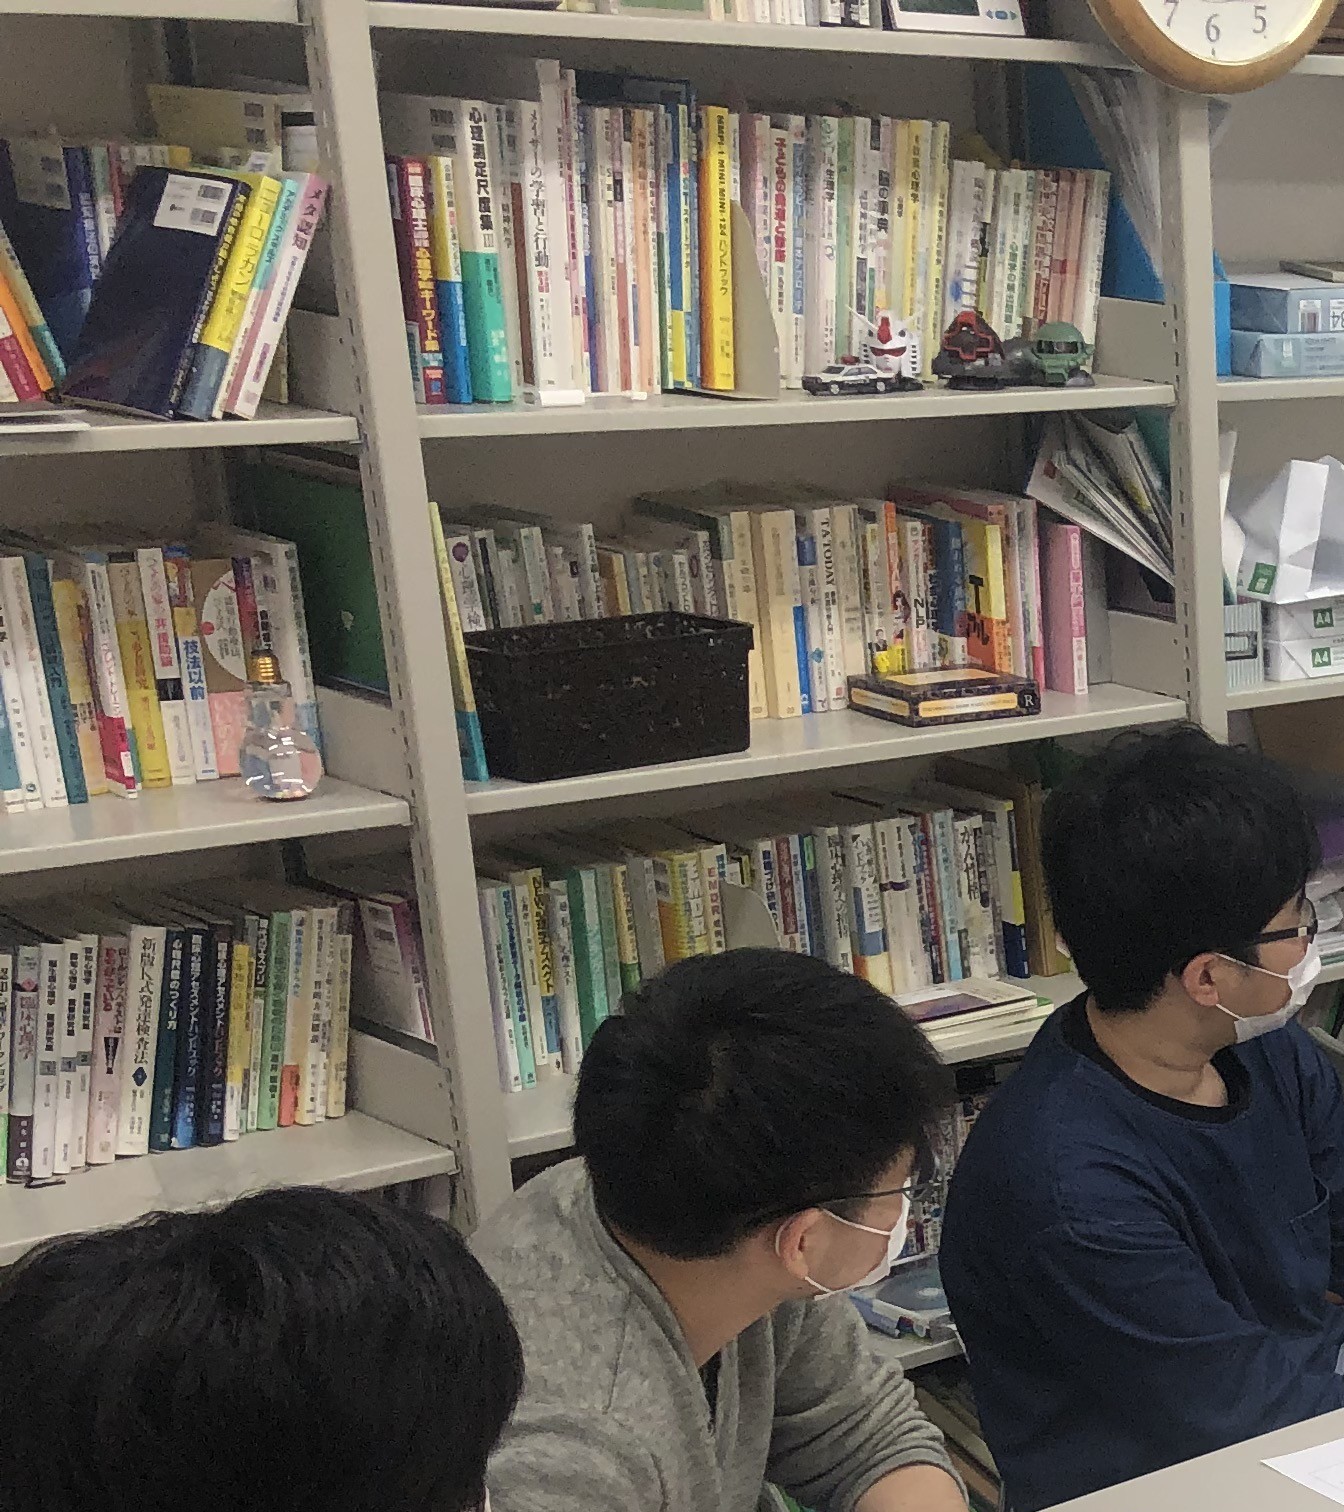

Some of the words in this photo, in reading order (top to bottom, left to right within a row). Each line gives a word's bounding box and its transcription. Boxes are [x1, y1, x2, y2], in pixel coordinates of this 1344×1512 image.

[1204, 13, 1221, 42] 6
[1252, 5, 1267, 35] 5
[1315, 611, 1331, 624] A4
[183, 640, 205, 700] 技法以前
[1314, 651, 1328, 664] A4
[1024, 694, 1035, 707] R
[134, 936, 157, 1066] 新版K式発達検査法
